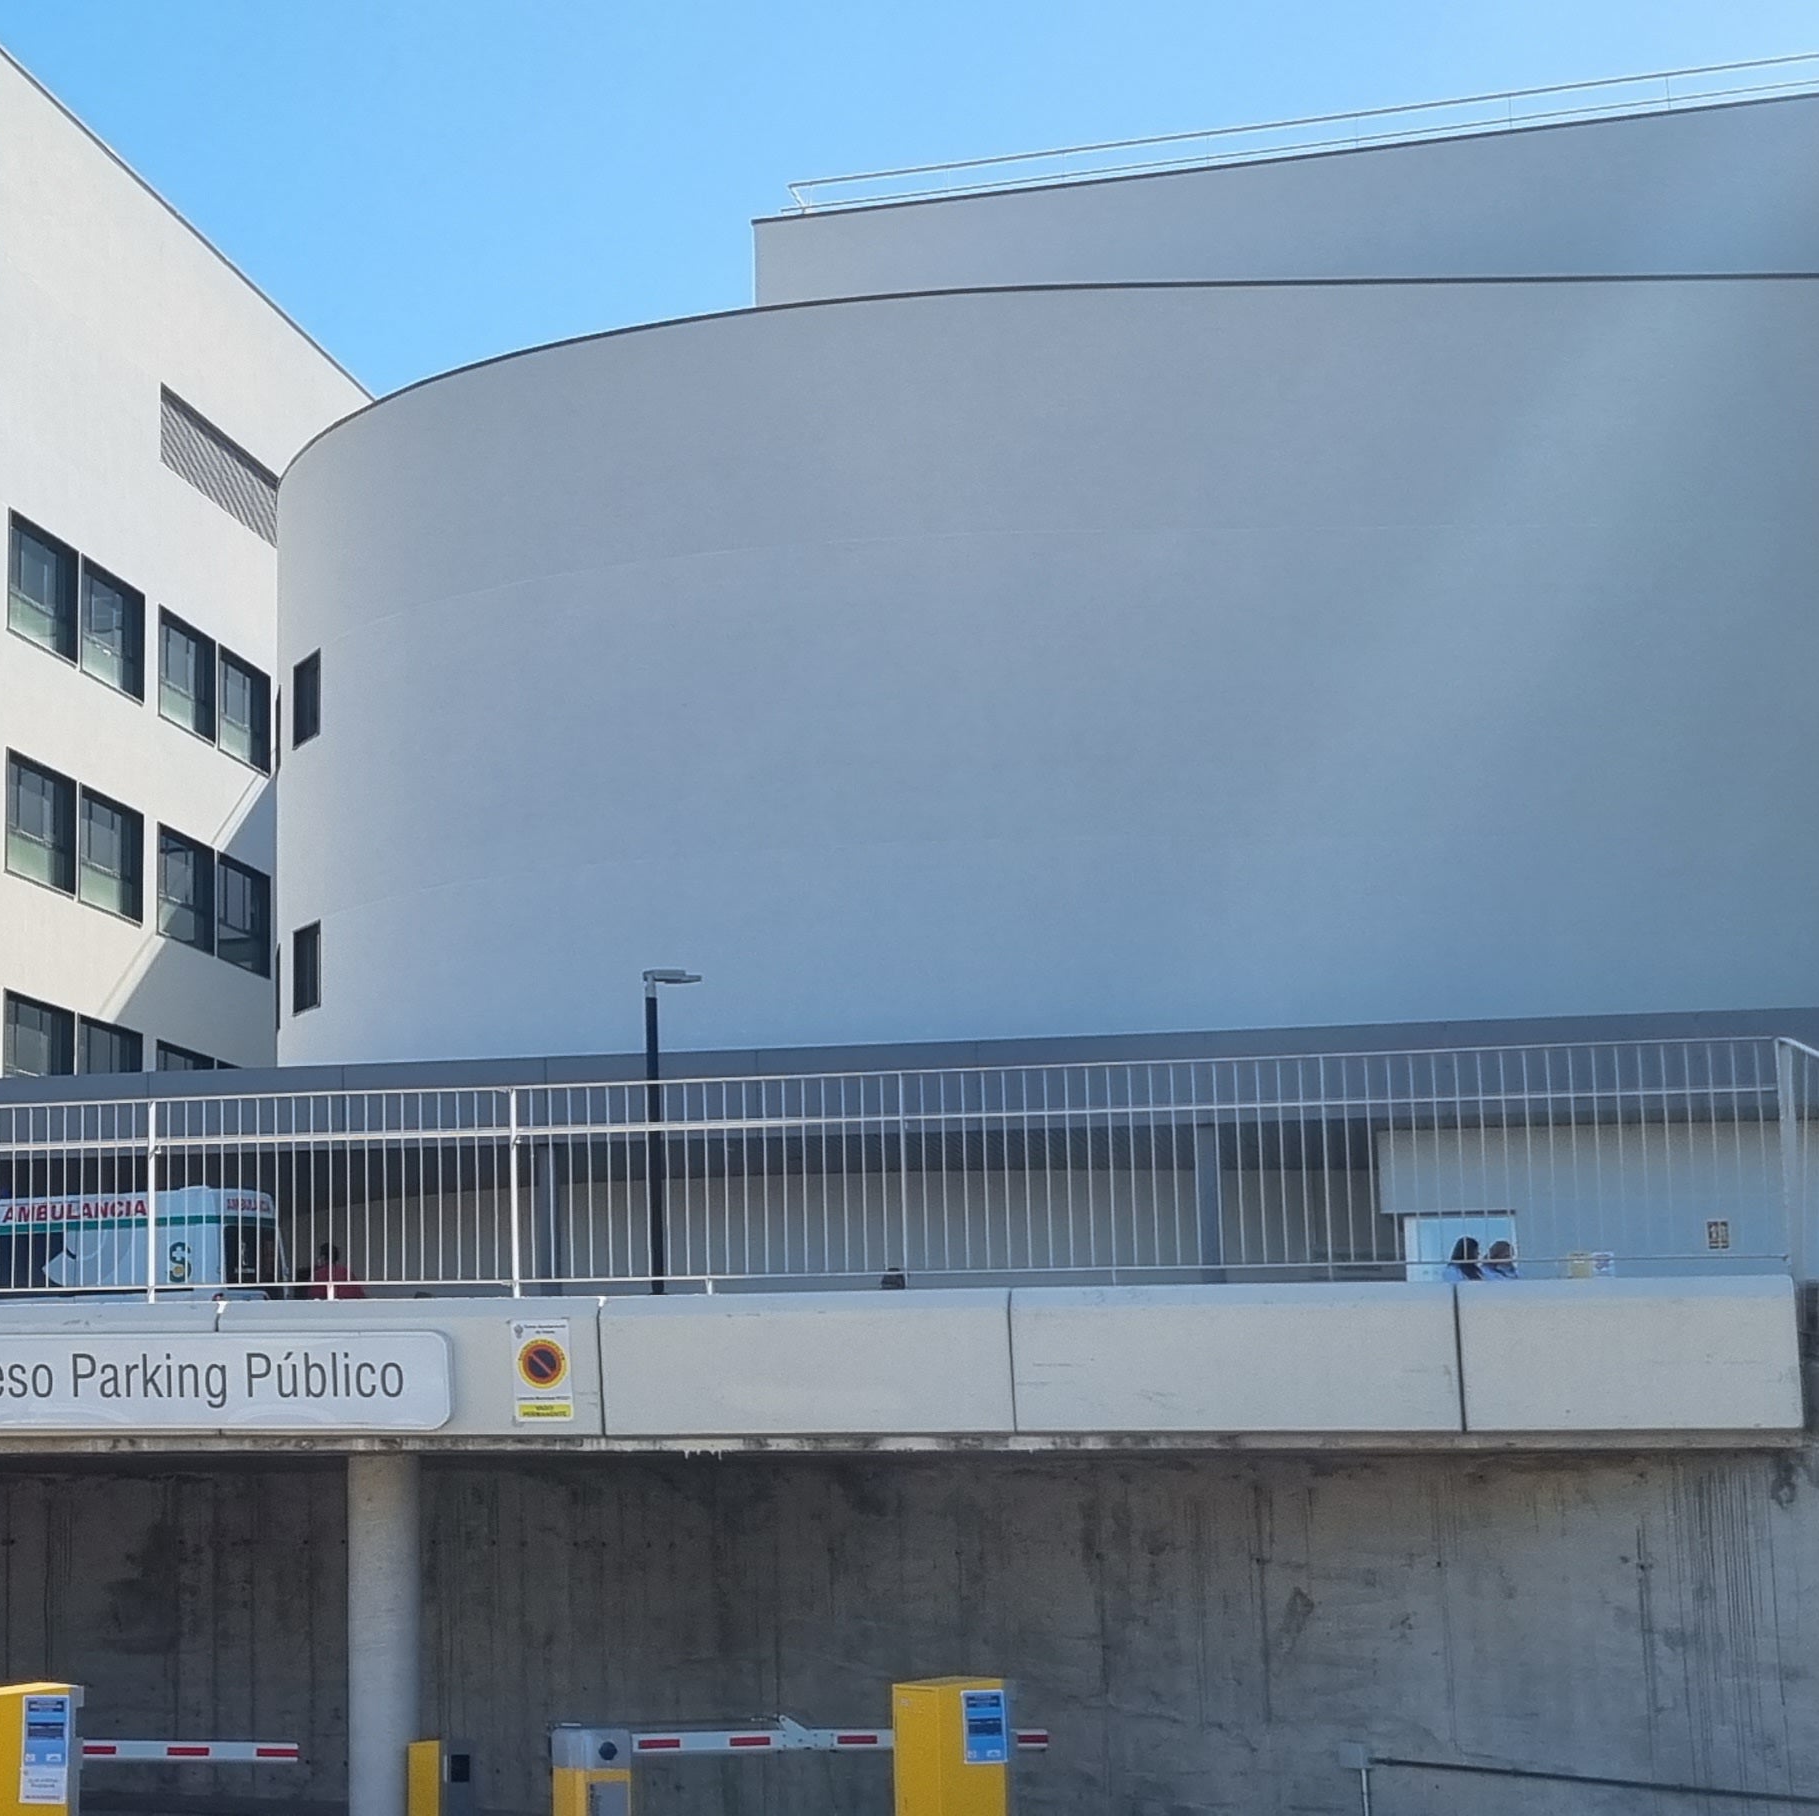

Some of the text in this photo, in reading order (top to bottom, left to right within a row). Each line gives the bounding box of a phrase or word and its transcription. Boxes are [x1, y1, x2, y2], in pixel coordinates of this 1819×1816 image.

[2, 1199, 148, 1223] AMBULANCIA
[71, 1352, 228, 1408] Parking
[246, 1350, 405, 1399] Público
